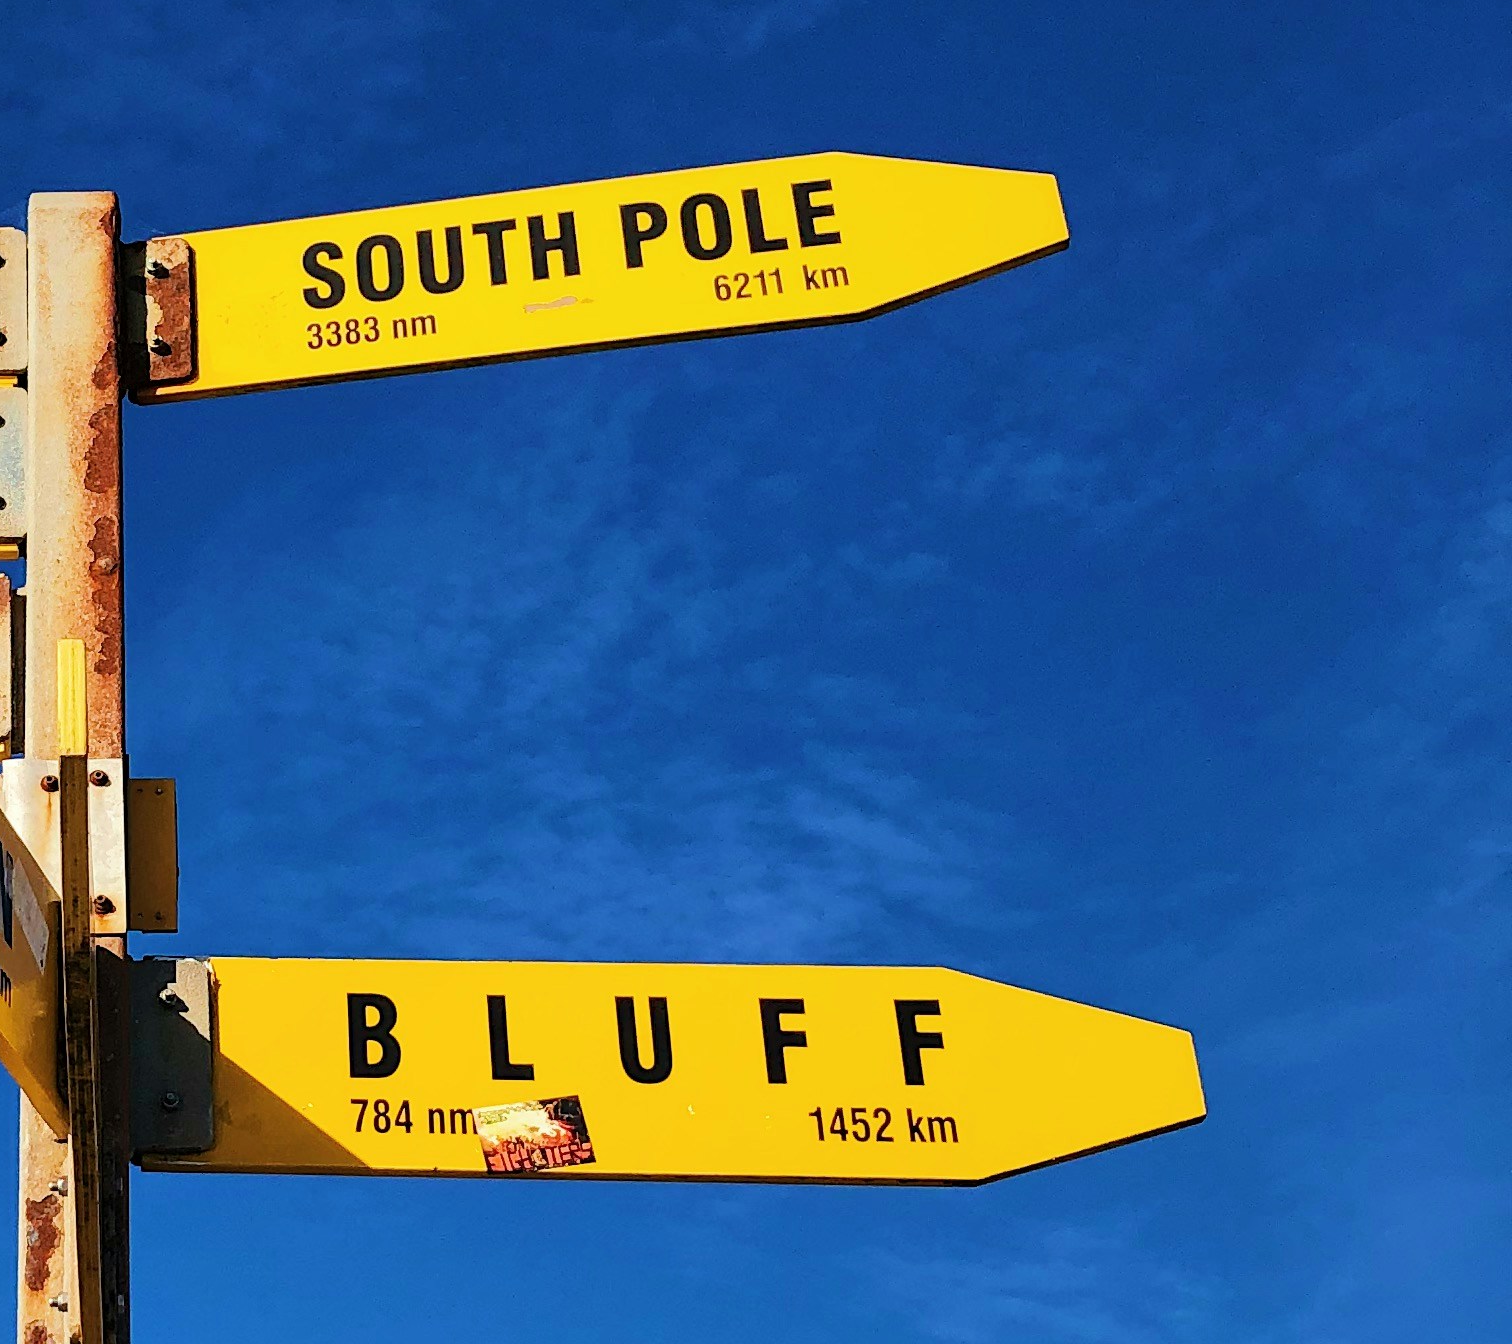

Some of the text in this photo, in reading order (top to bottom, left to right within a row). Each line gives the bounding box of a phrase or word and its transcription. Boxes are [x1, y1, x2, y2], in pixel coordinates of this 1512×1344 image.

[300, 179, 842, 309] SOUTH POLE
[713, 262, 849, 303] 6211 km
[306, 312, 437, 351] 3383 nm
[346, 992, 946, 1086] BLUFF
[350, 1099, 412, 1134] 784
[426, 1107, 479, 1135] nm
[808, 1106, 959, 1143] 1452 km
